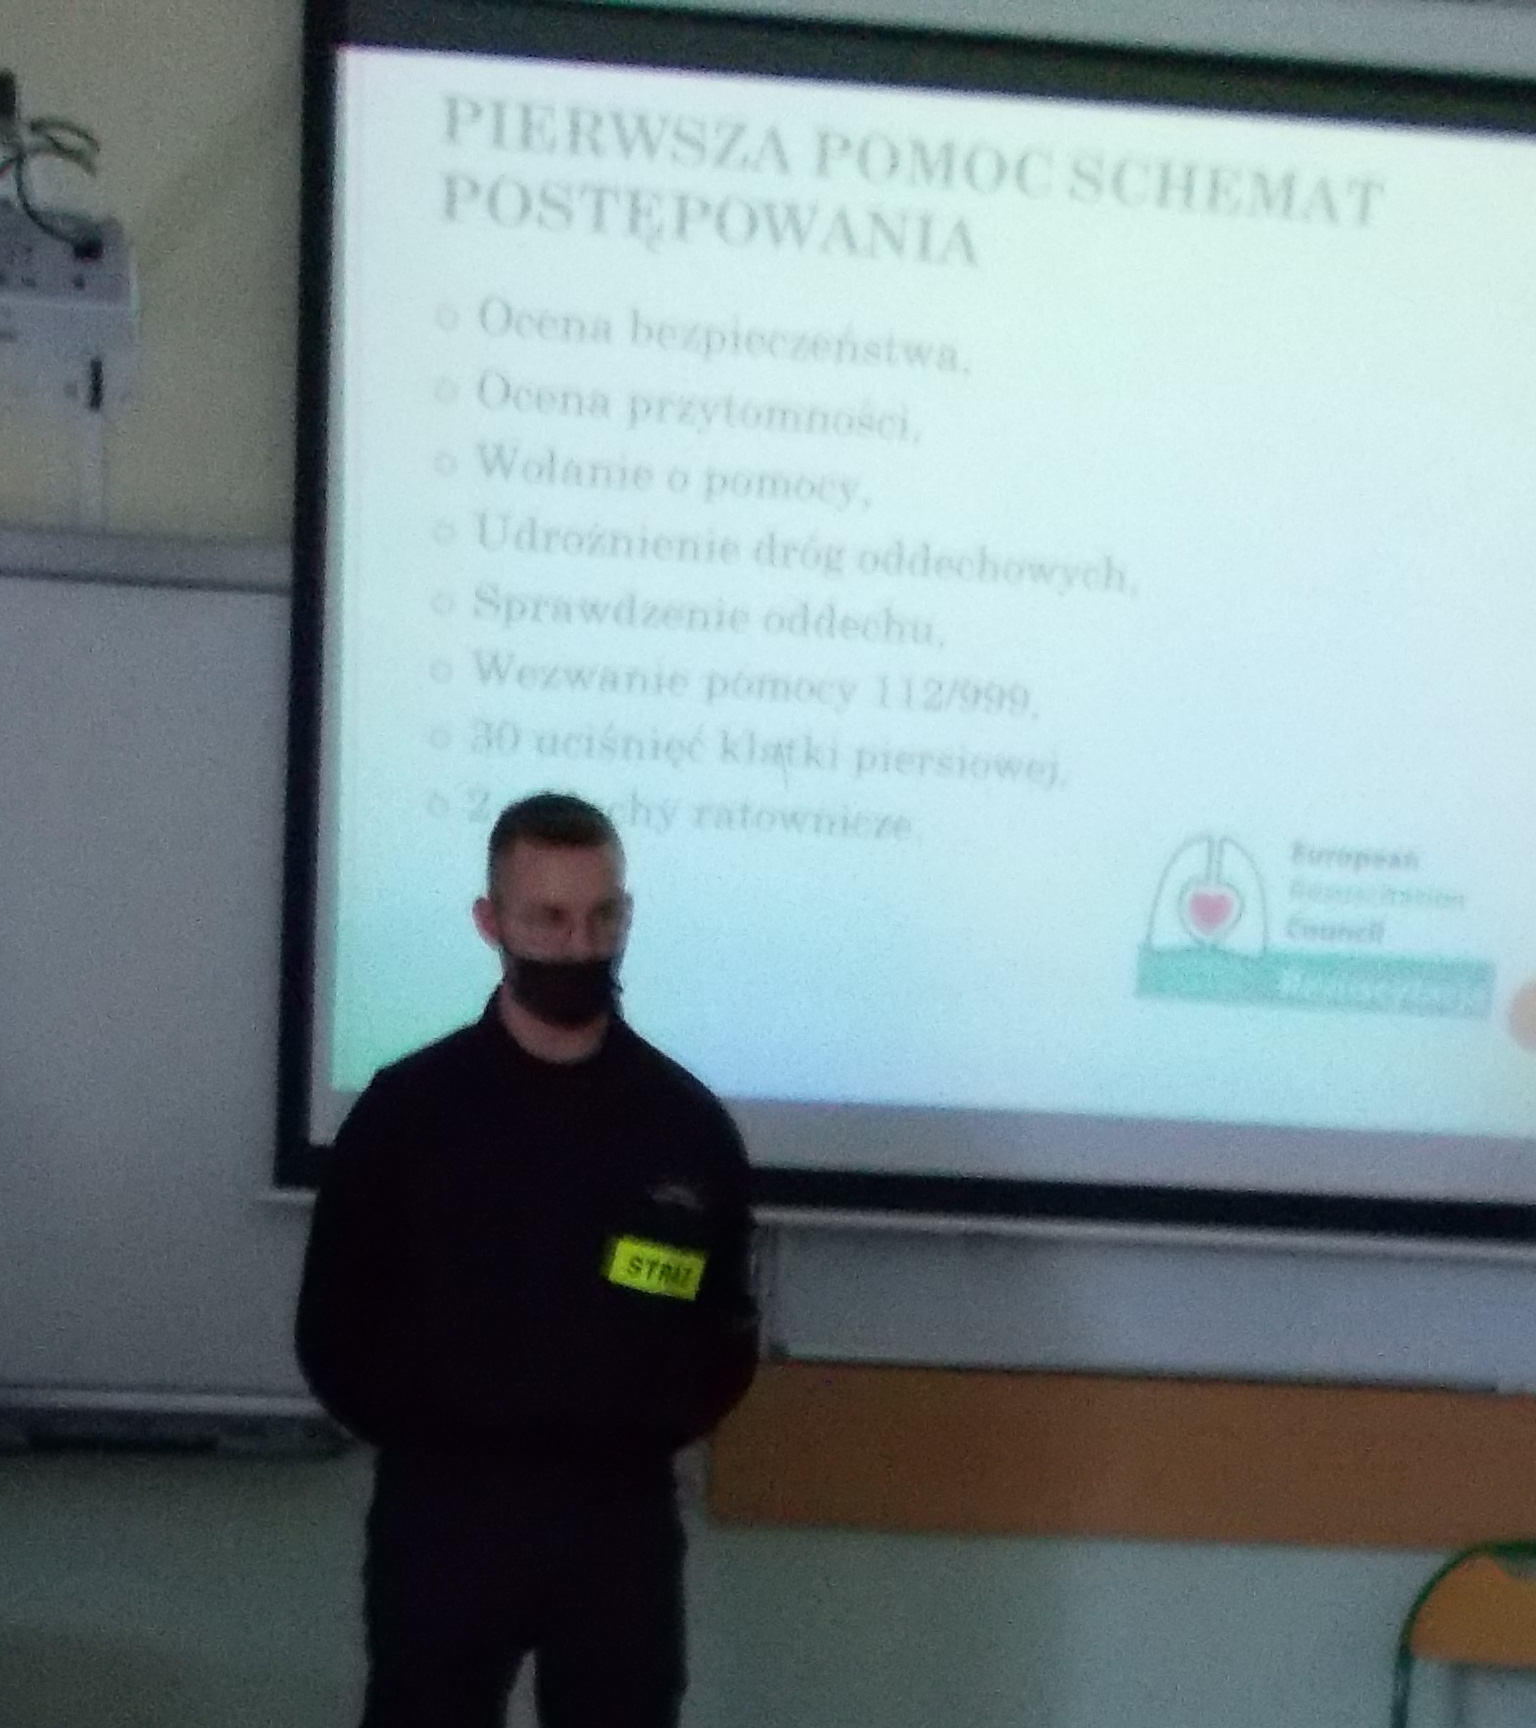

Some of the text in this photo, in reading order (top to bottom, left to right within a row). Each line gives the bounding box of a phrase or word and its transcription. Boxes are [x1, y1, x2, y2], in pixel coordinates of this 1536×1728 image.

[442, 92, 1386, 229] PIERWSZA POMOC SCHEMAT
[440, 168, 980, 268] POSTĘPOWANIA
[476, 291, 613, 346] Ocena
[474, 367, 611, 420] Ocena
[666, 465, 691, 495] o
[702, 464, 872, 514] pomocy,
[752, 530, 846, 580] dróg
[856, 536, 1140, 599] oddechowych,
[471, 578, 946, 652] Sprawdzenie oddechu,
[470, 648, 691, 698] Wezwanie
[702, 668, 858, 715] pomocy
[467, 713, 523, 754] 30
[465, 785, 492, 825] 2
